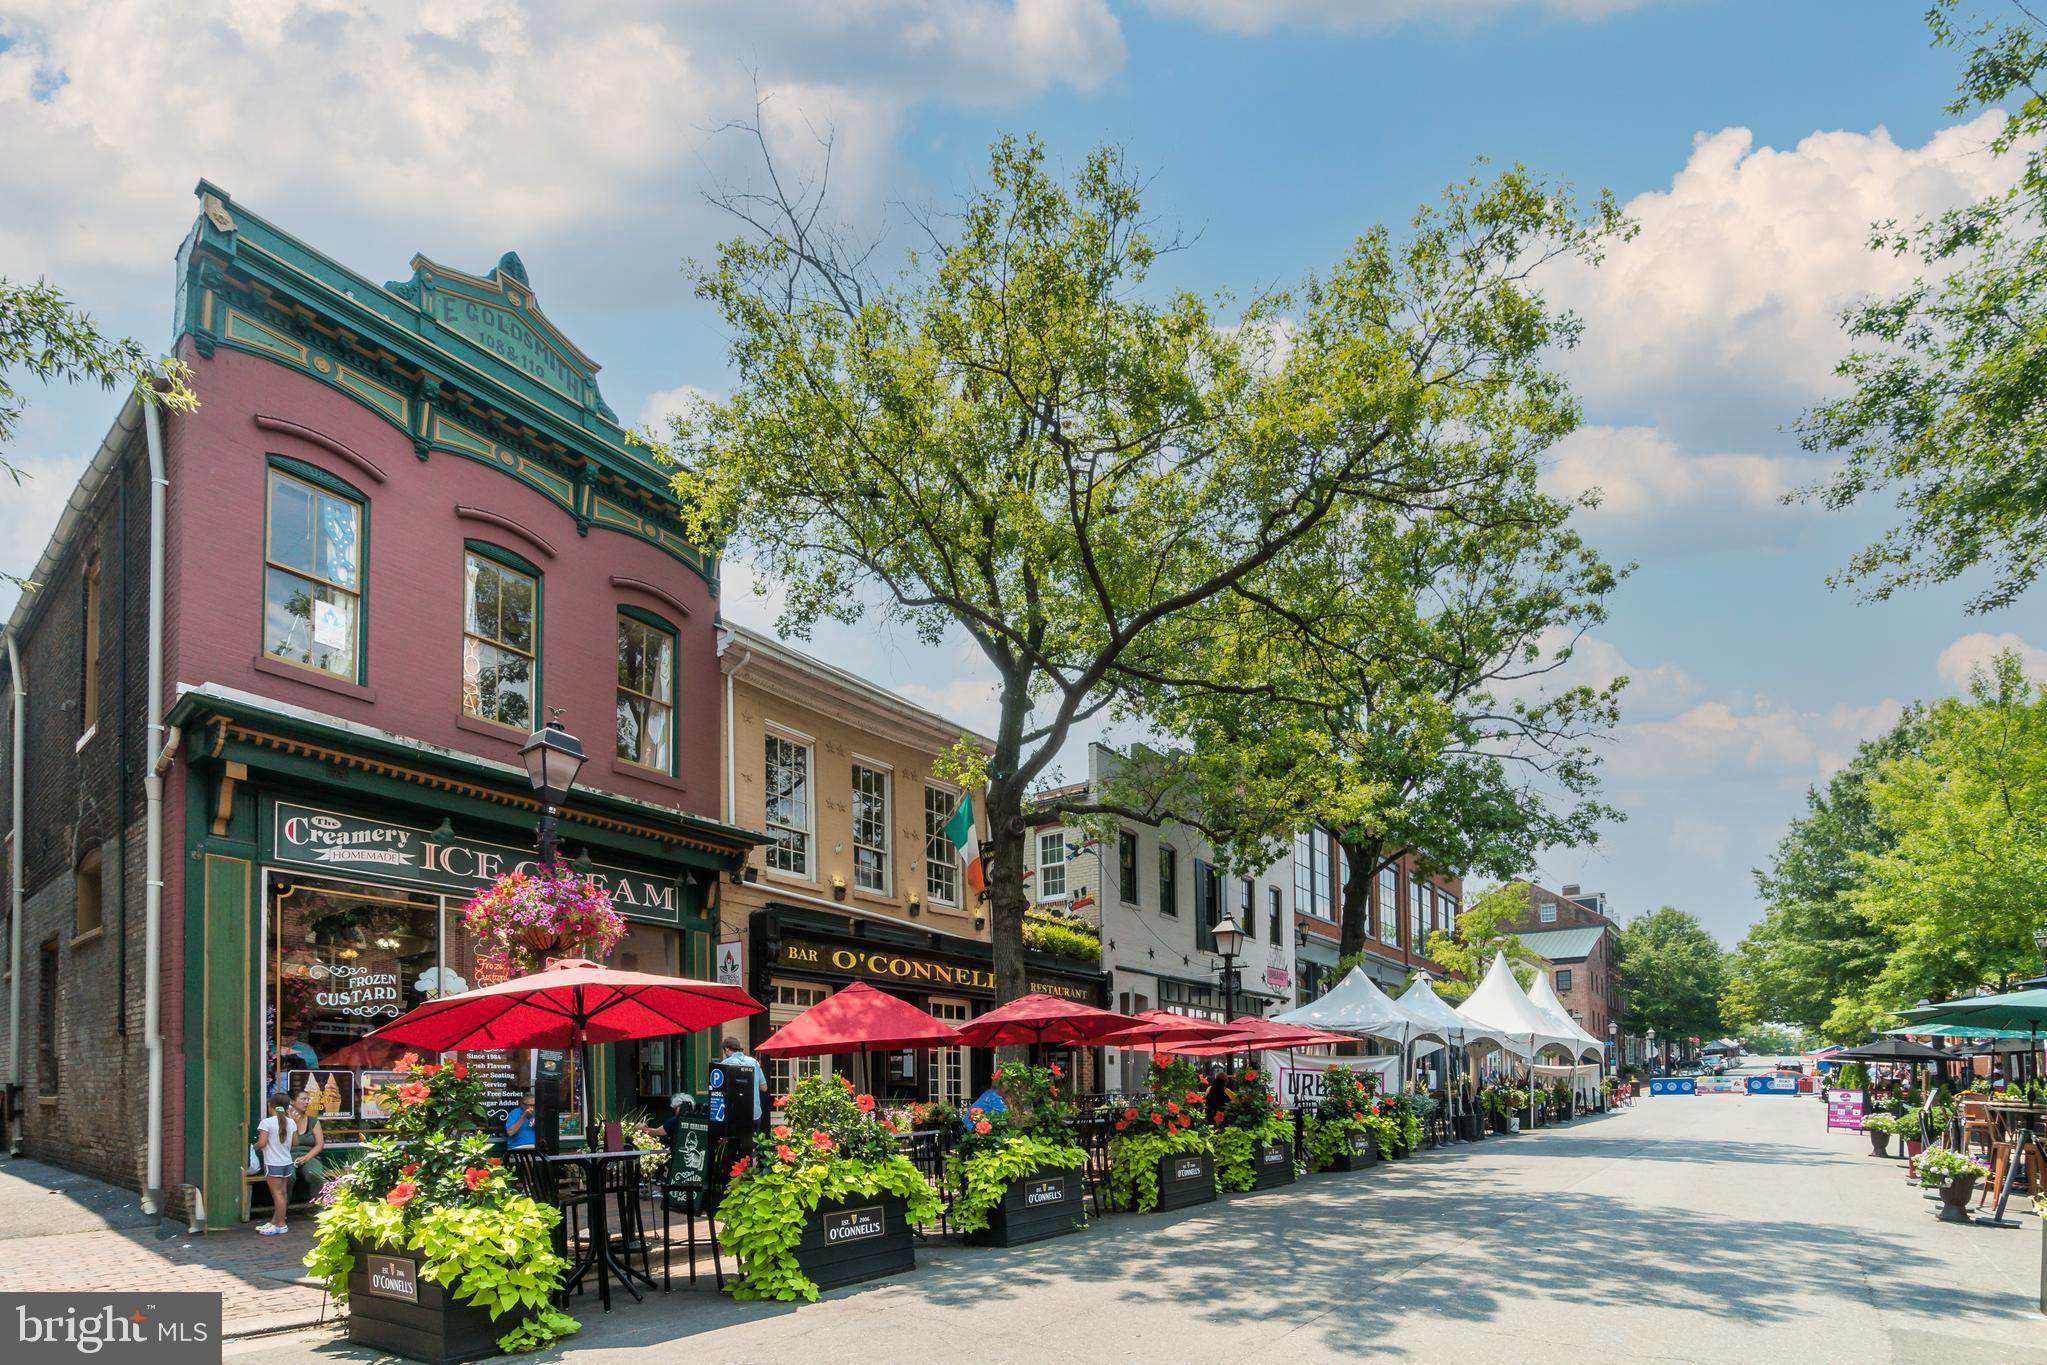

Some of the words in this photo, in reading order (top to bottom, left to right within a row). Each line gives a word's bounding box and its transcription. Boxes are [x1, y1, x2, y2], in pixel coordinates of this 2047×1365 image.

[443, 297, 458, 323] E
[465, 302, 580, 400] GOLDSMITH
[315, 817, 338, 827] The
[284, 816, 411, 849] Creamery
[333, 851, 397, 862] HOMEMADE
[419, 841, 504, 880] ICE
[788, 946, 819, 963] BAR
[831, 949, 998, 989] O'CONNELL
[349, 974, 397, 989] FROZEN
[1029, 981, 1089, 1000] RESTAURANT
[316, 986, 397, 1006] CUSTARD
[713, 1072, 720, 1085] P
[1028, 1190, 1062, 1204] O'CONNELL'S
[829, 1222, 881, 1240] O'CONNELL'S
[372, 1273, 414, 1295] O'CONNELL'S
